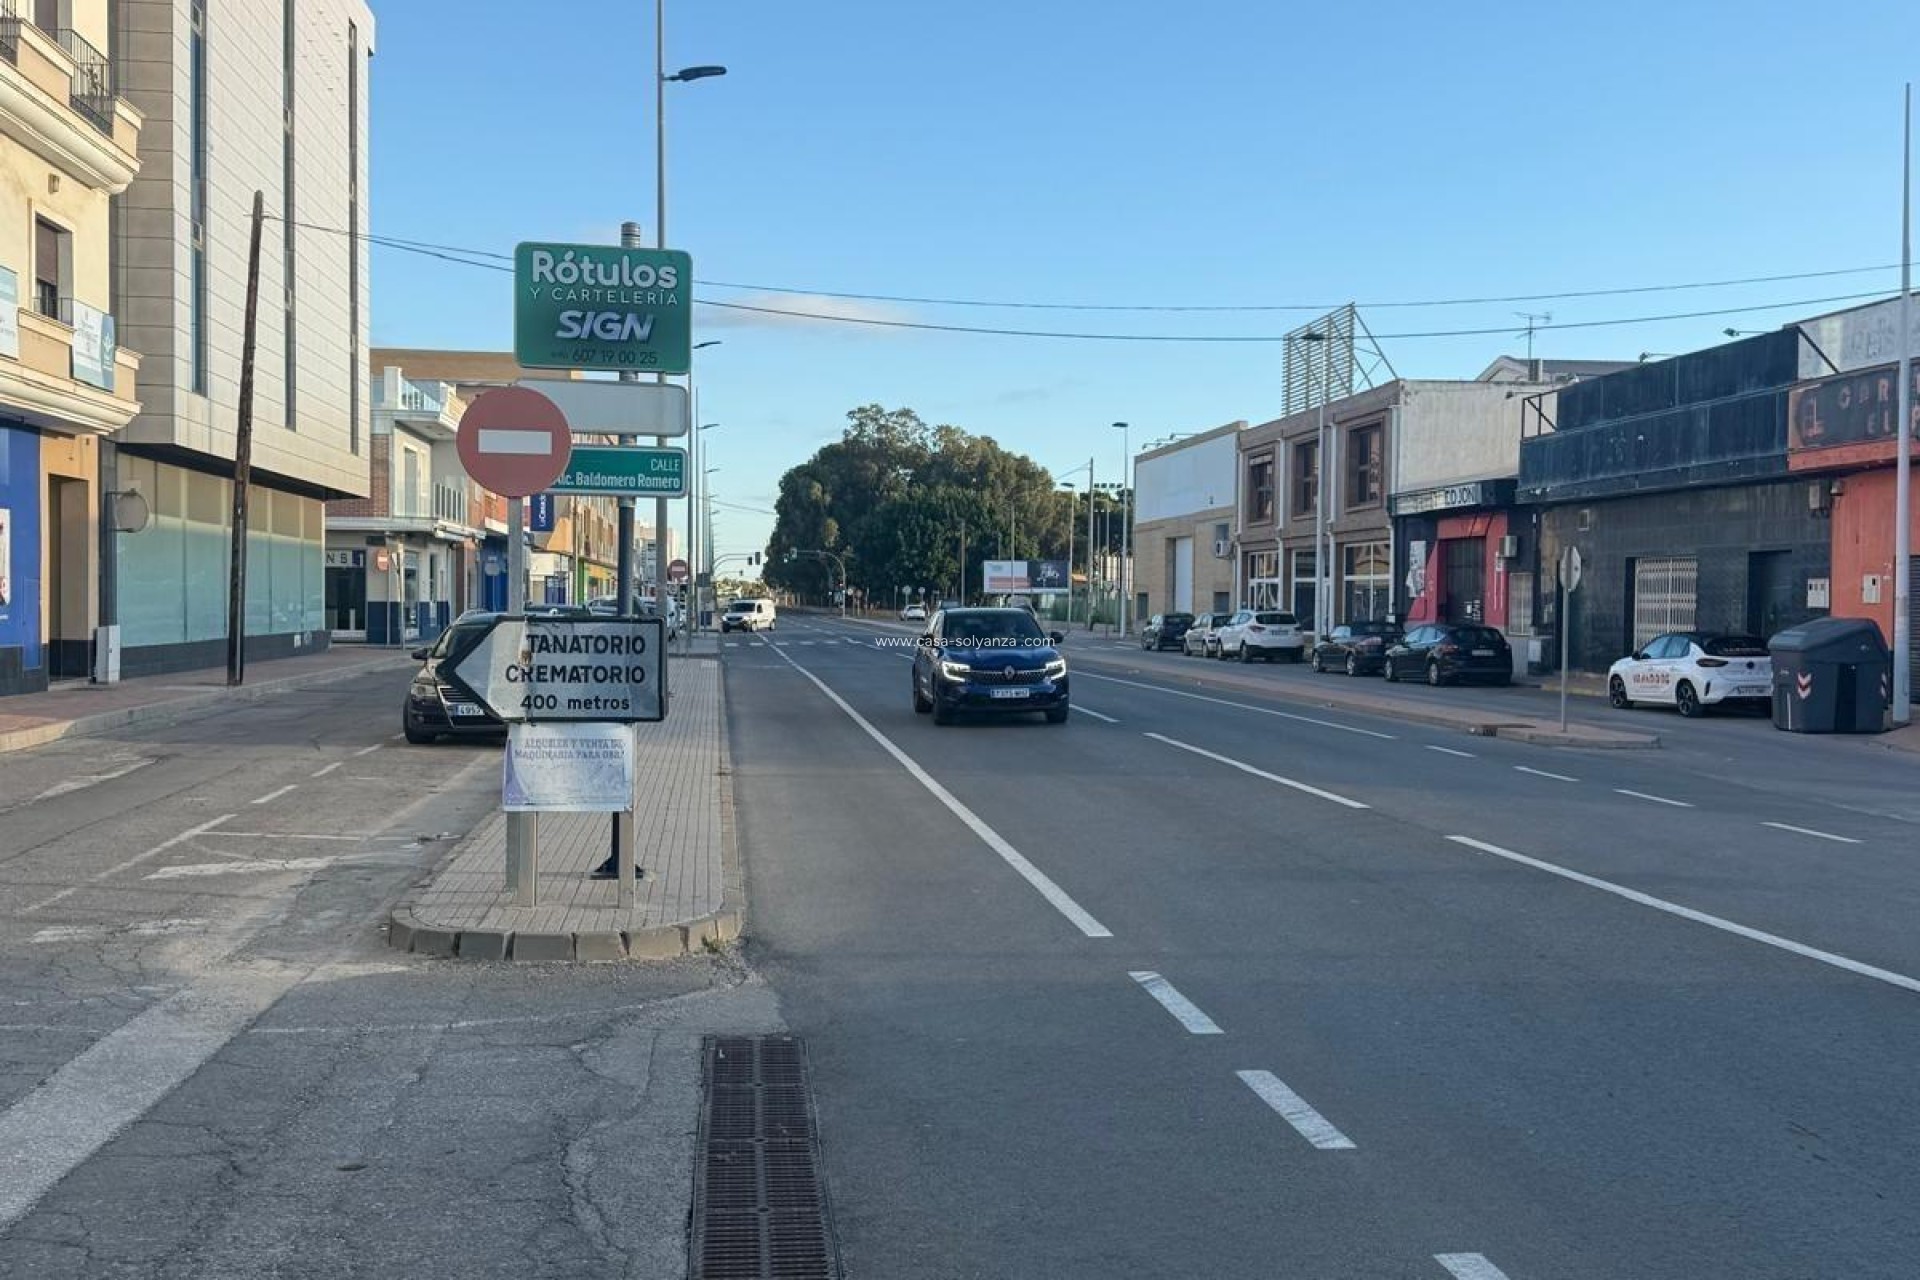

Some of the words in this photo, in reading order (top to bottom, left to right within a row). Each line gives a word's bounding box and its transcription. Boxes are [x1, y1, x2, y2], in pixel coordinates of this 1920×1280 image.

[532, 250, 678, 289] Rótulos
[530, 287, 541, 299] Y
[552, 287, 678, 305] CARTELERÍA
[556, 310, 654, 341] SIGN
[601, 350, 615, 364] 19
[618, 351, 636, 364] 00
[639, 351, 657, 365] 25
[651, 458, 680, 471] CALLE
[575, 472, 636, 488] Baldomero
[638, 474, 681, 489] Romero
[526, 634, 646, 655] TANATORIO
[505, 664, 646, 684] CREMATORIO
[520, 694, 557, 710] 400
[567, 696, 630, 710] metros
